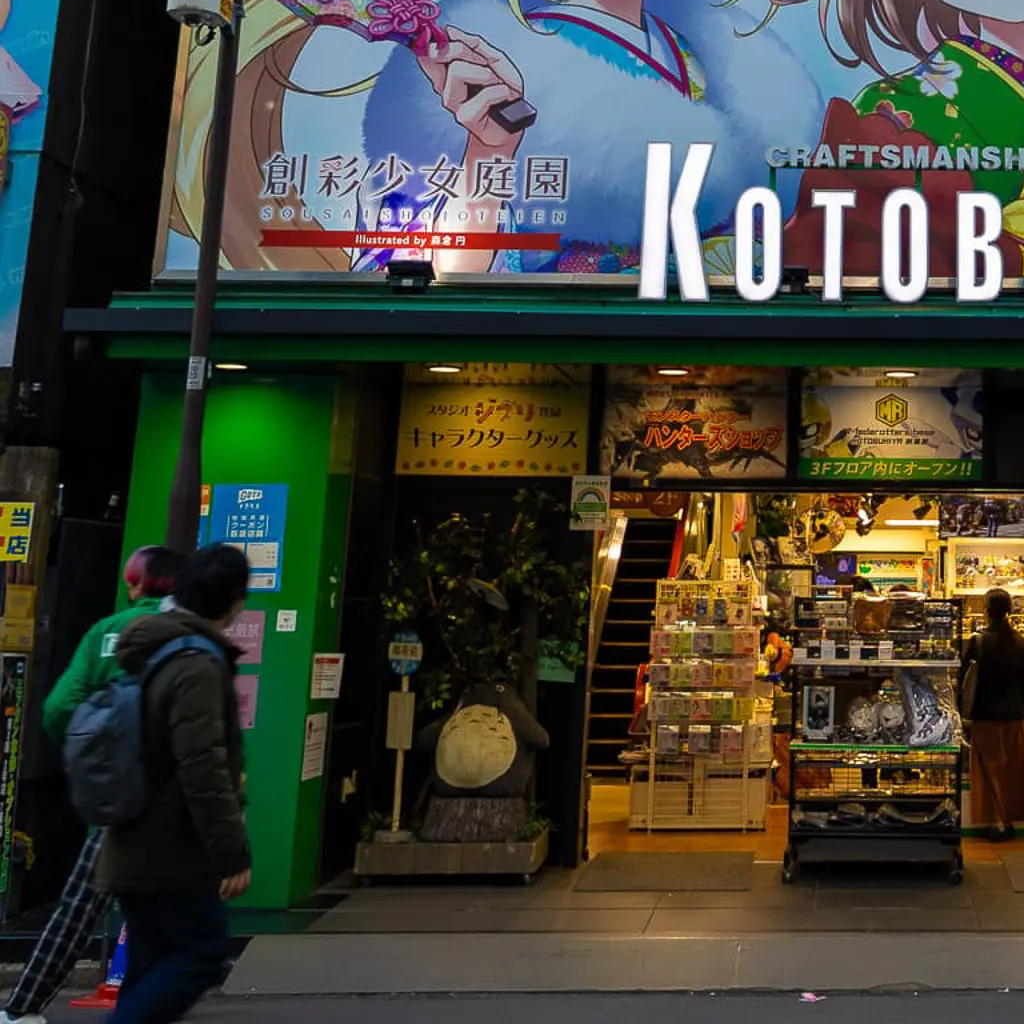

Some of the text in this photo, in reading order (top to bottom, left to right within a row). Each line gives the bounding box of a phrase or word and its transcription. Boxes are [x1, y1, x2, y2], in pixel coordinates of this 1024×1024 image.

[260, 153, 570, 202] 創彩少女庭園
[355, 234, 410, 247] Illustrated
[414, 235, 427, 248] by
[402, 426, 581, 449] キャラクターグッズ
[643, 424, 785, 453] ハンターズショップ
[230, 521, 266, 529] クーポン
